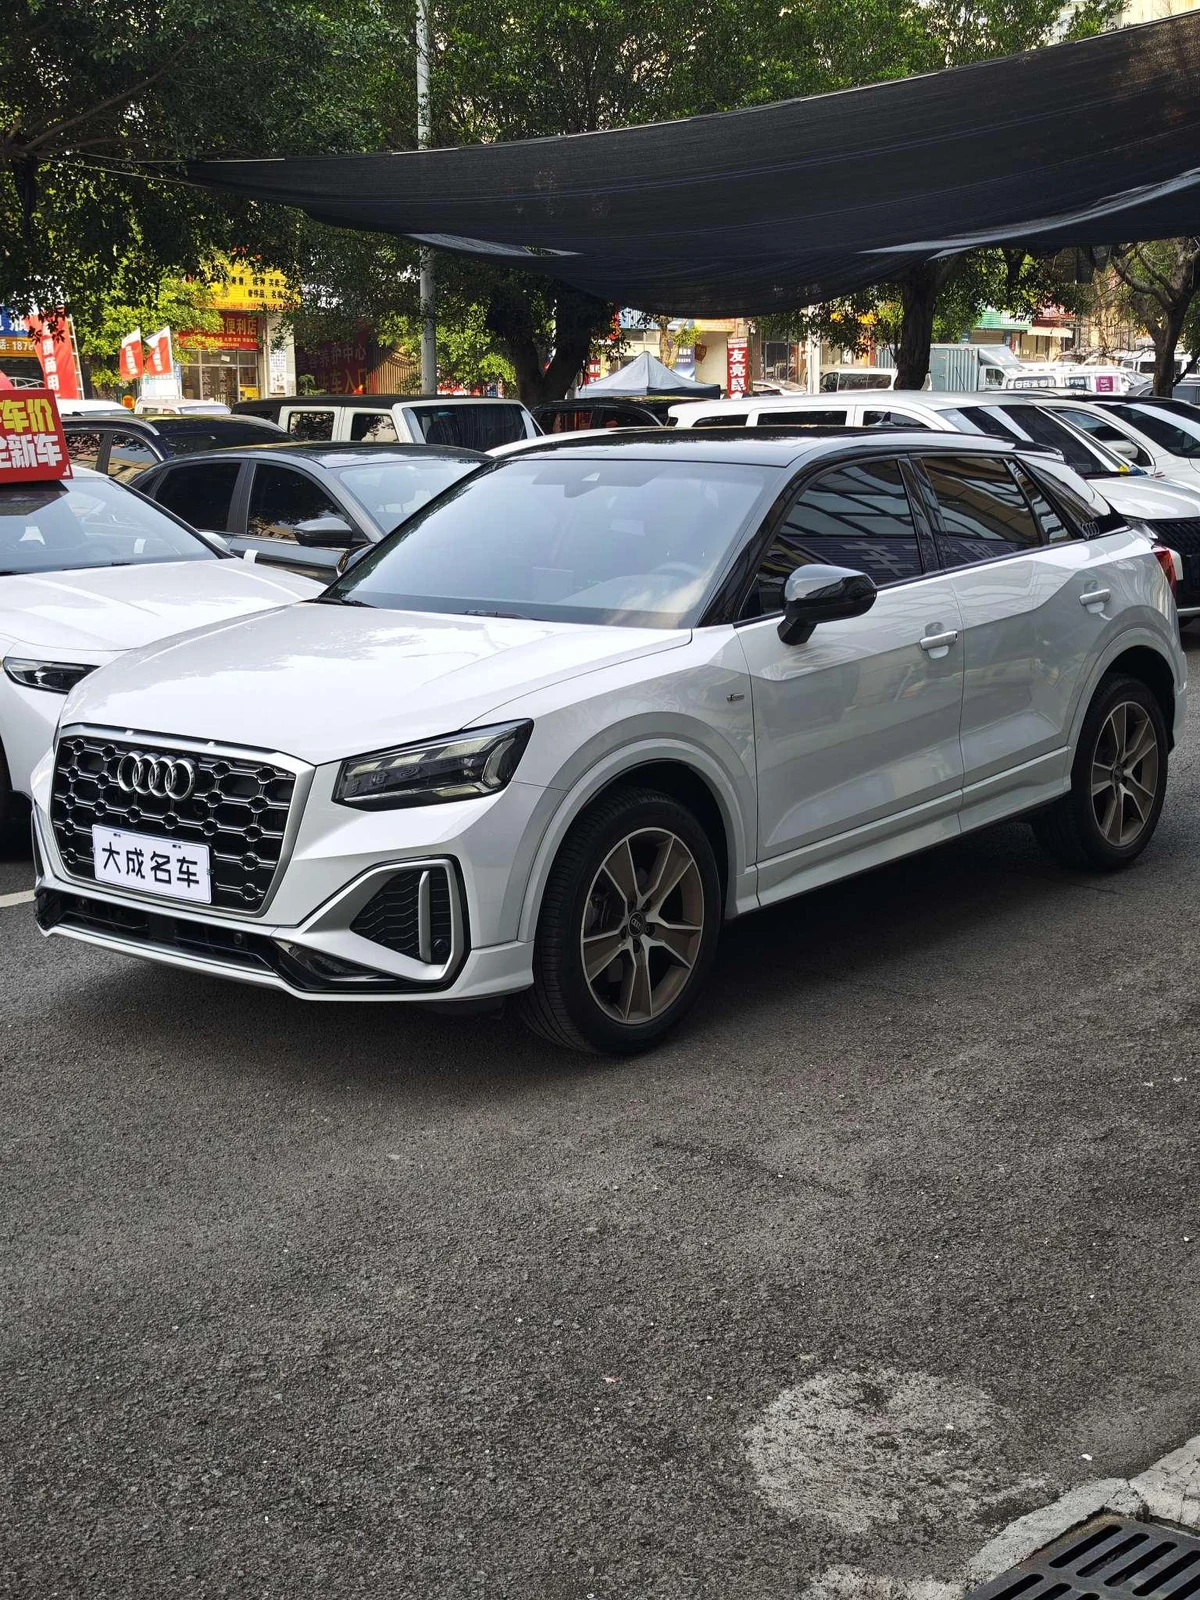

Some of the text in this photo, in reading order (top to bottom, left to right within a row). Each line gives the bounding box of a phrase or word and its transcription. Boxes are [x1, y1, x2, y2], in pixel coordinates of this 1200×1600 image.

[0, 399, 56, 433] 车价
[101, 841, 200, 888] 大成名车
